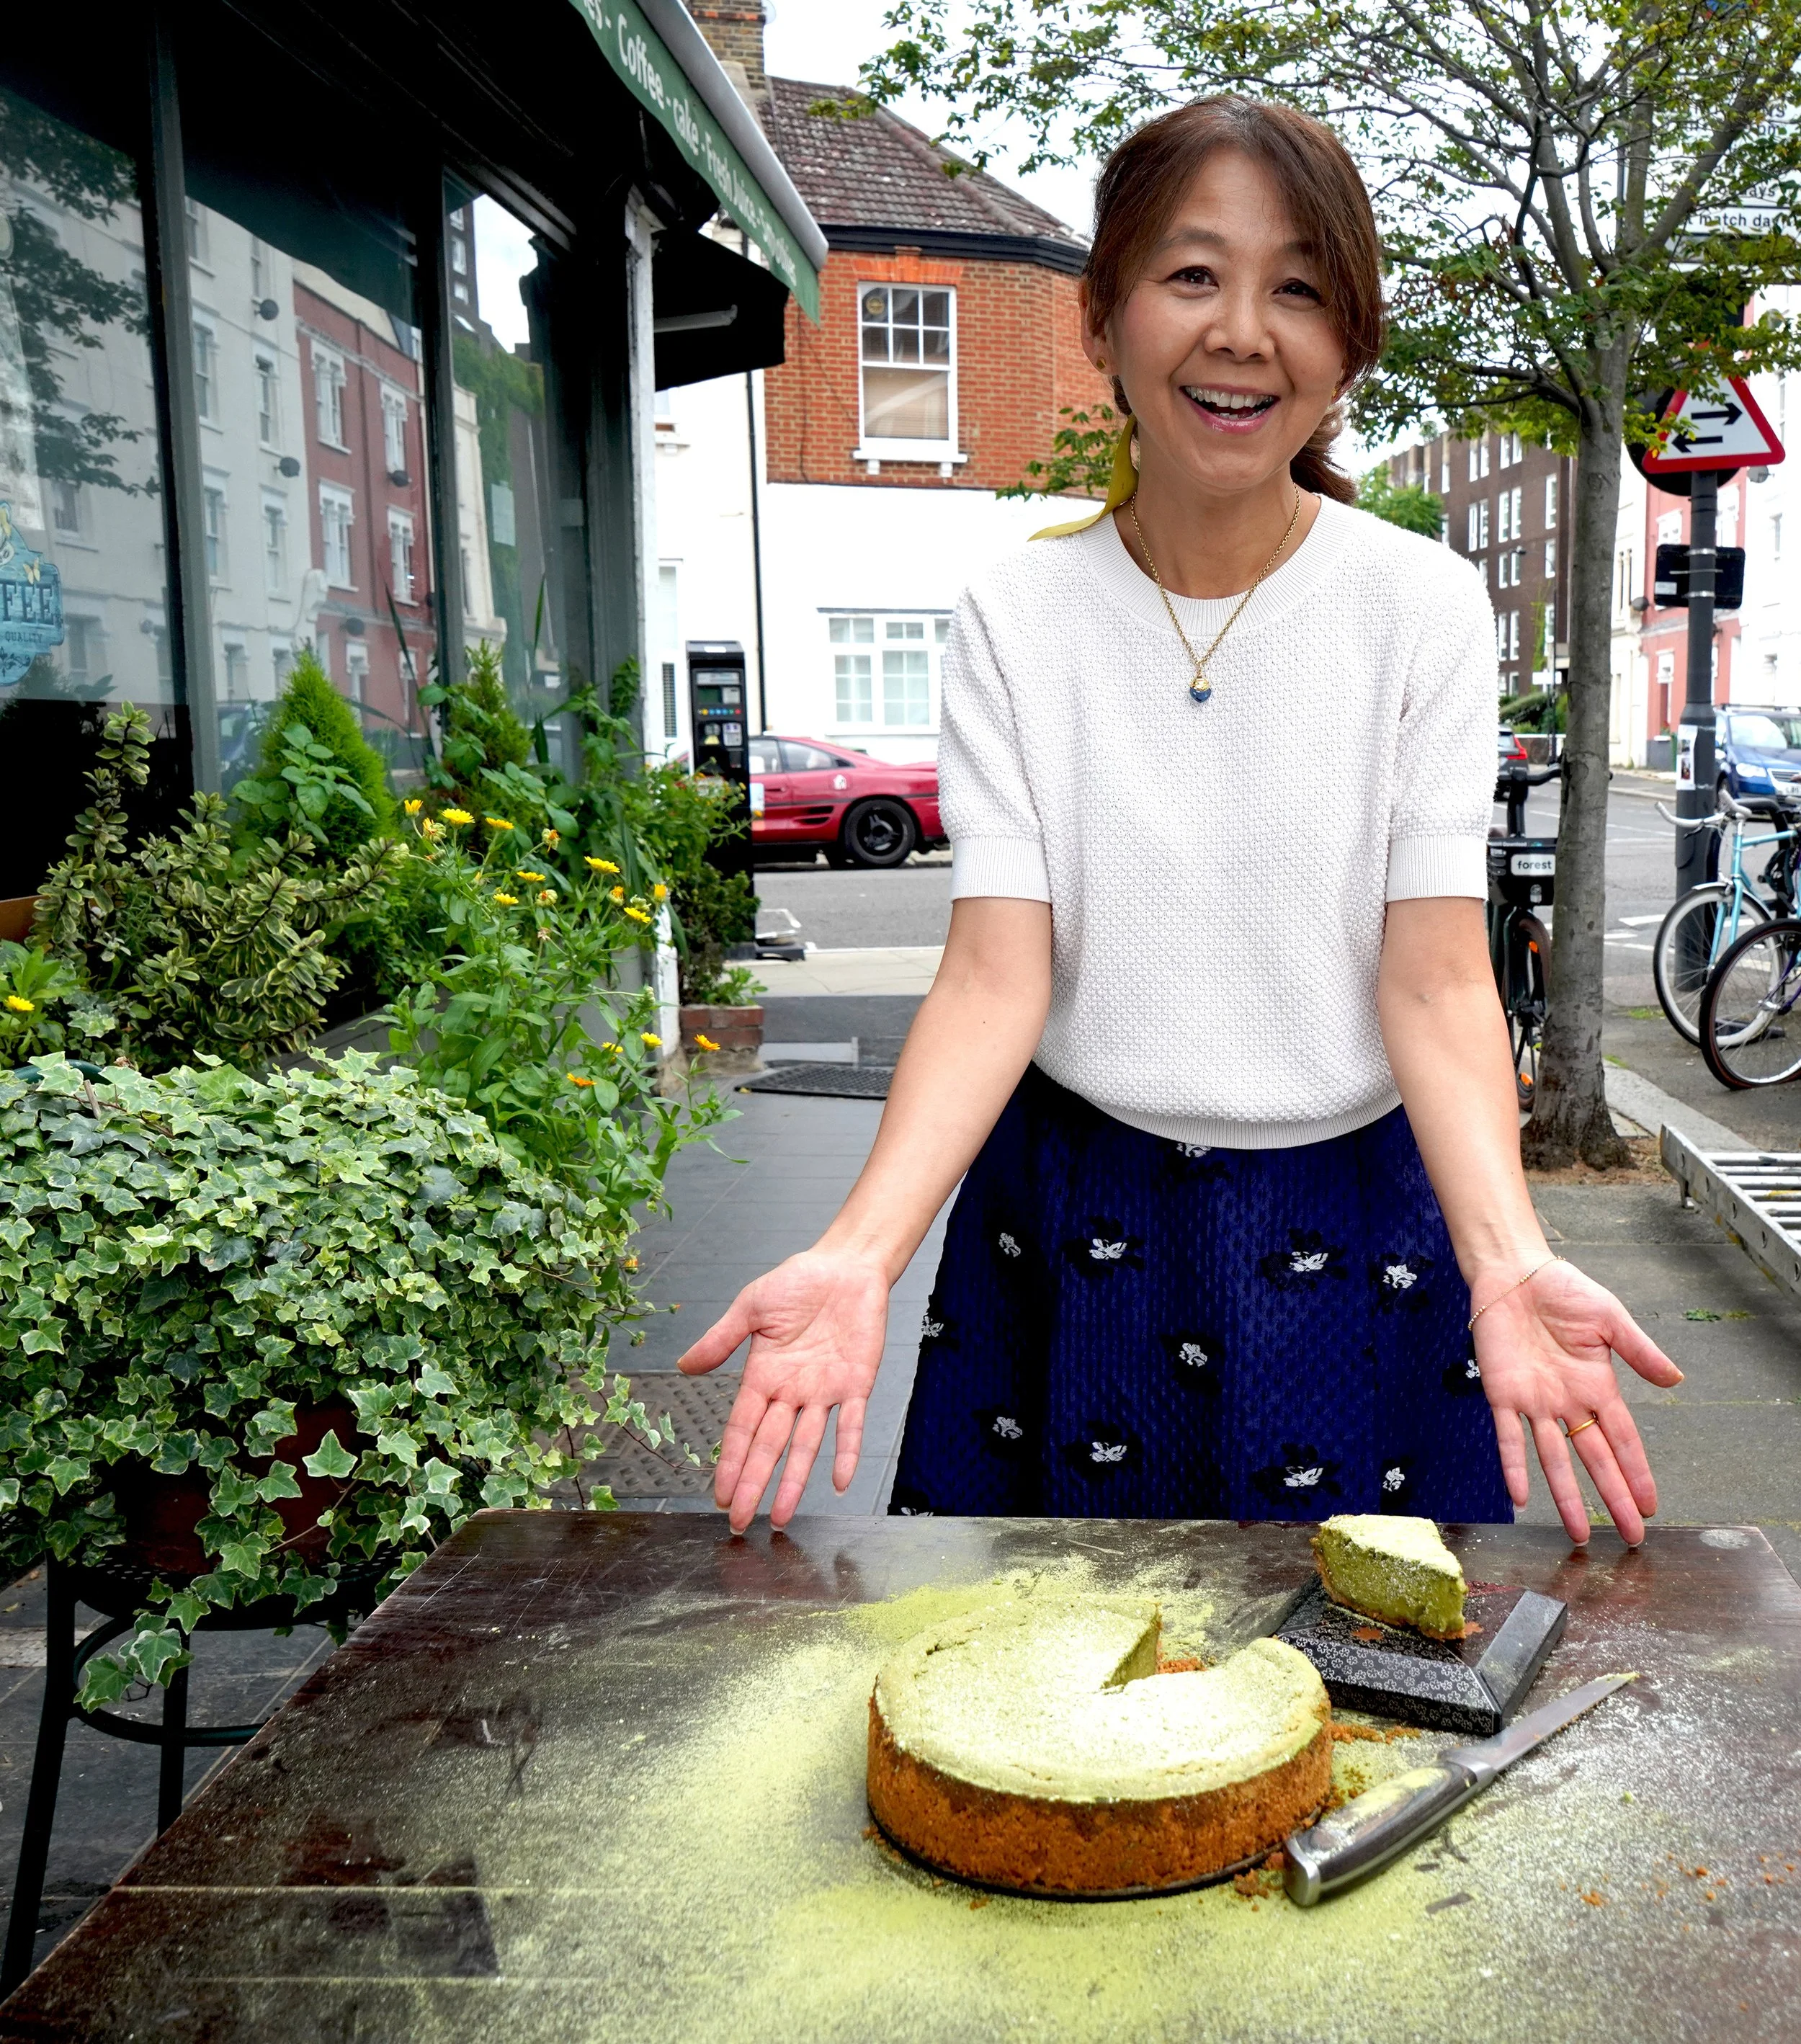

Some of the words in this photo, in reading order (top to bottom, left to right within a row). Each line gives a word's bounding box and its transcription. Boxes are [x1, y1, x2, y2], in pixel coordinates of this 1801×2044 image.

[618, 14, 665, 110] Coffee
[705, 132, 733, 202] Fresh
[5, 630, 43, 643] QUALITY
[1517, 860, 1552, 870] forest
